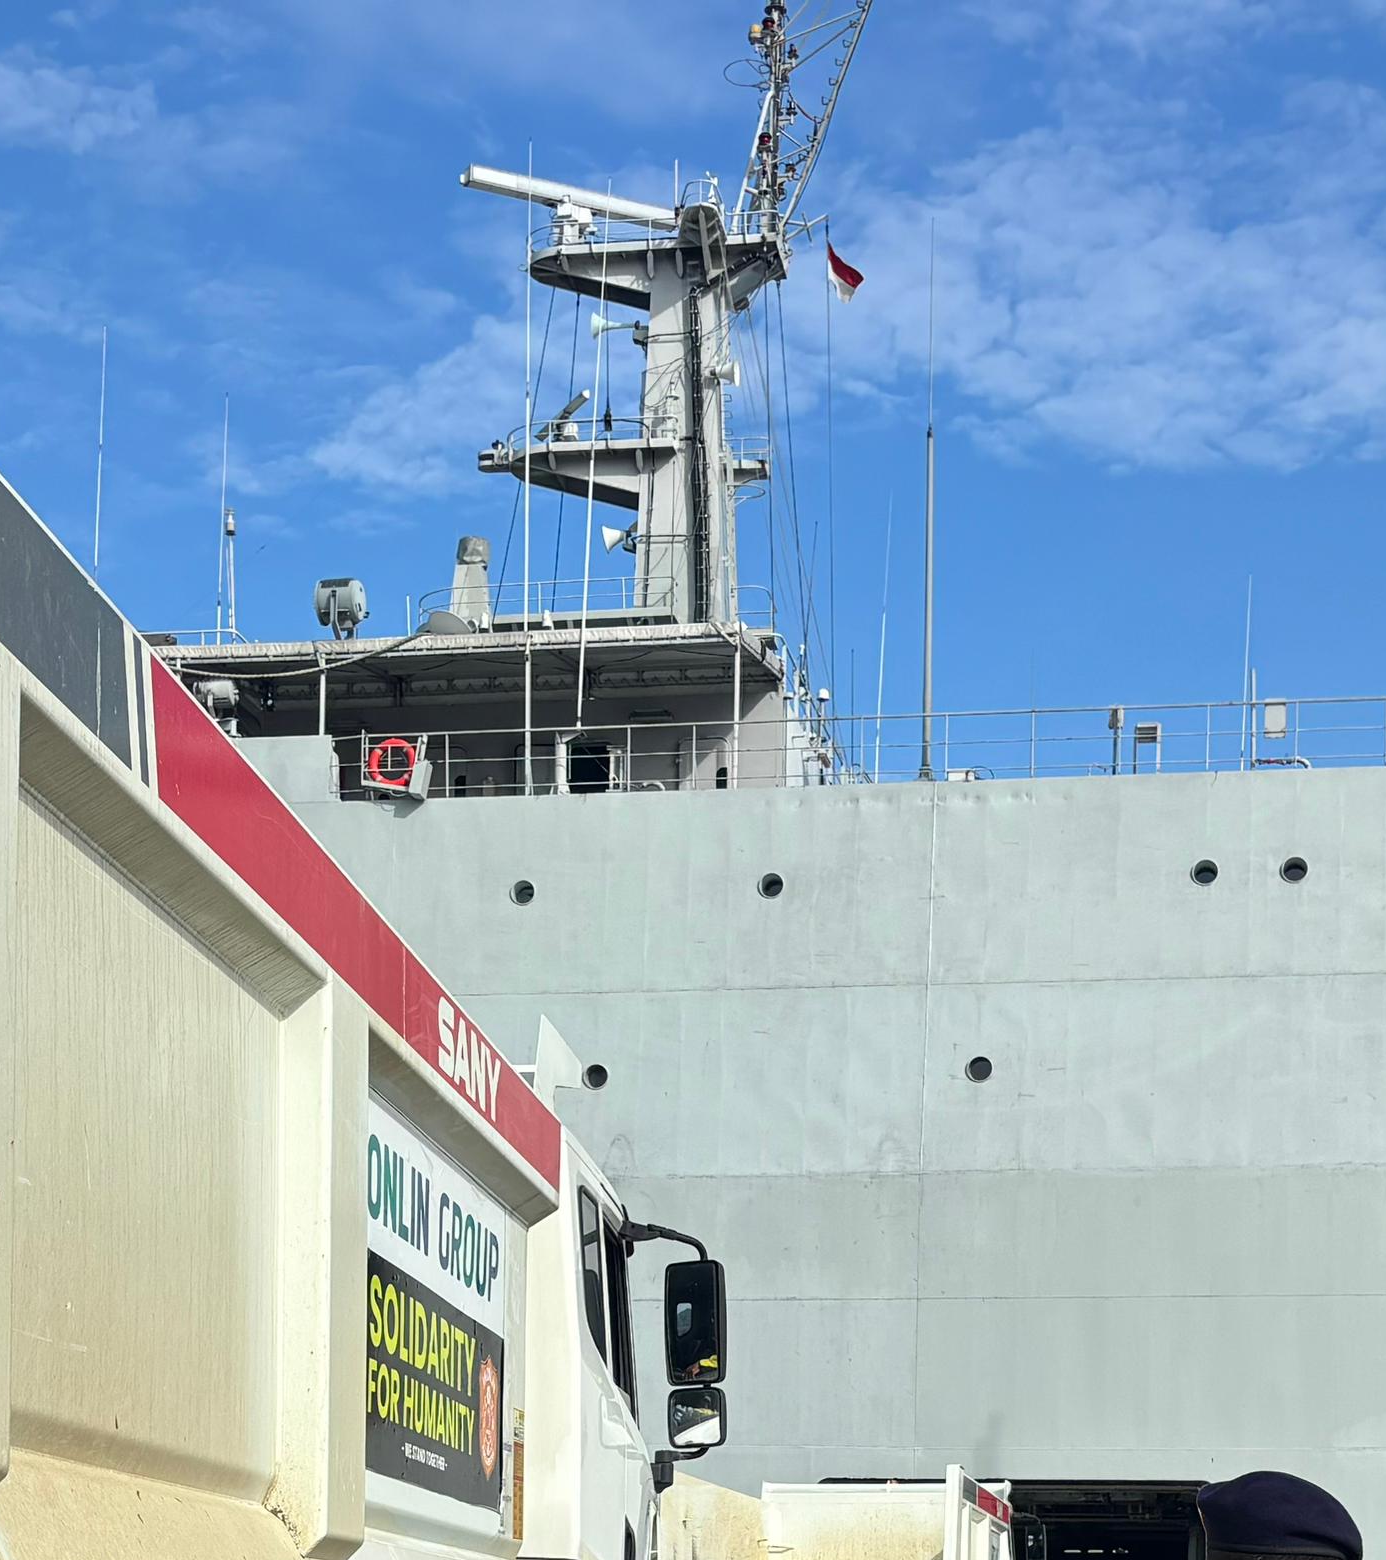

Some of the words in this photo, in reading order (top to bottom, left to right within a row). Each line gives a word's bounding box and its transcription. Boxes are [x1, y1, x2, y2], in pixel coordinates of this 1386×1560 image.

[437, 996, 501, 1123] SANY
[438, 1192, 500, 1302] GROUP
[368, 1273, 476, 1397] SOLIDARITY
[367, 1358, 400, 1425] FOR
[402, 1374, 475, 1456] HUMANITY
